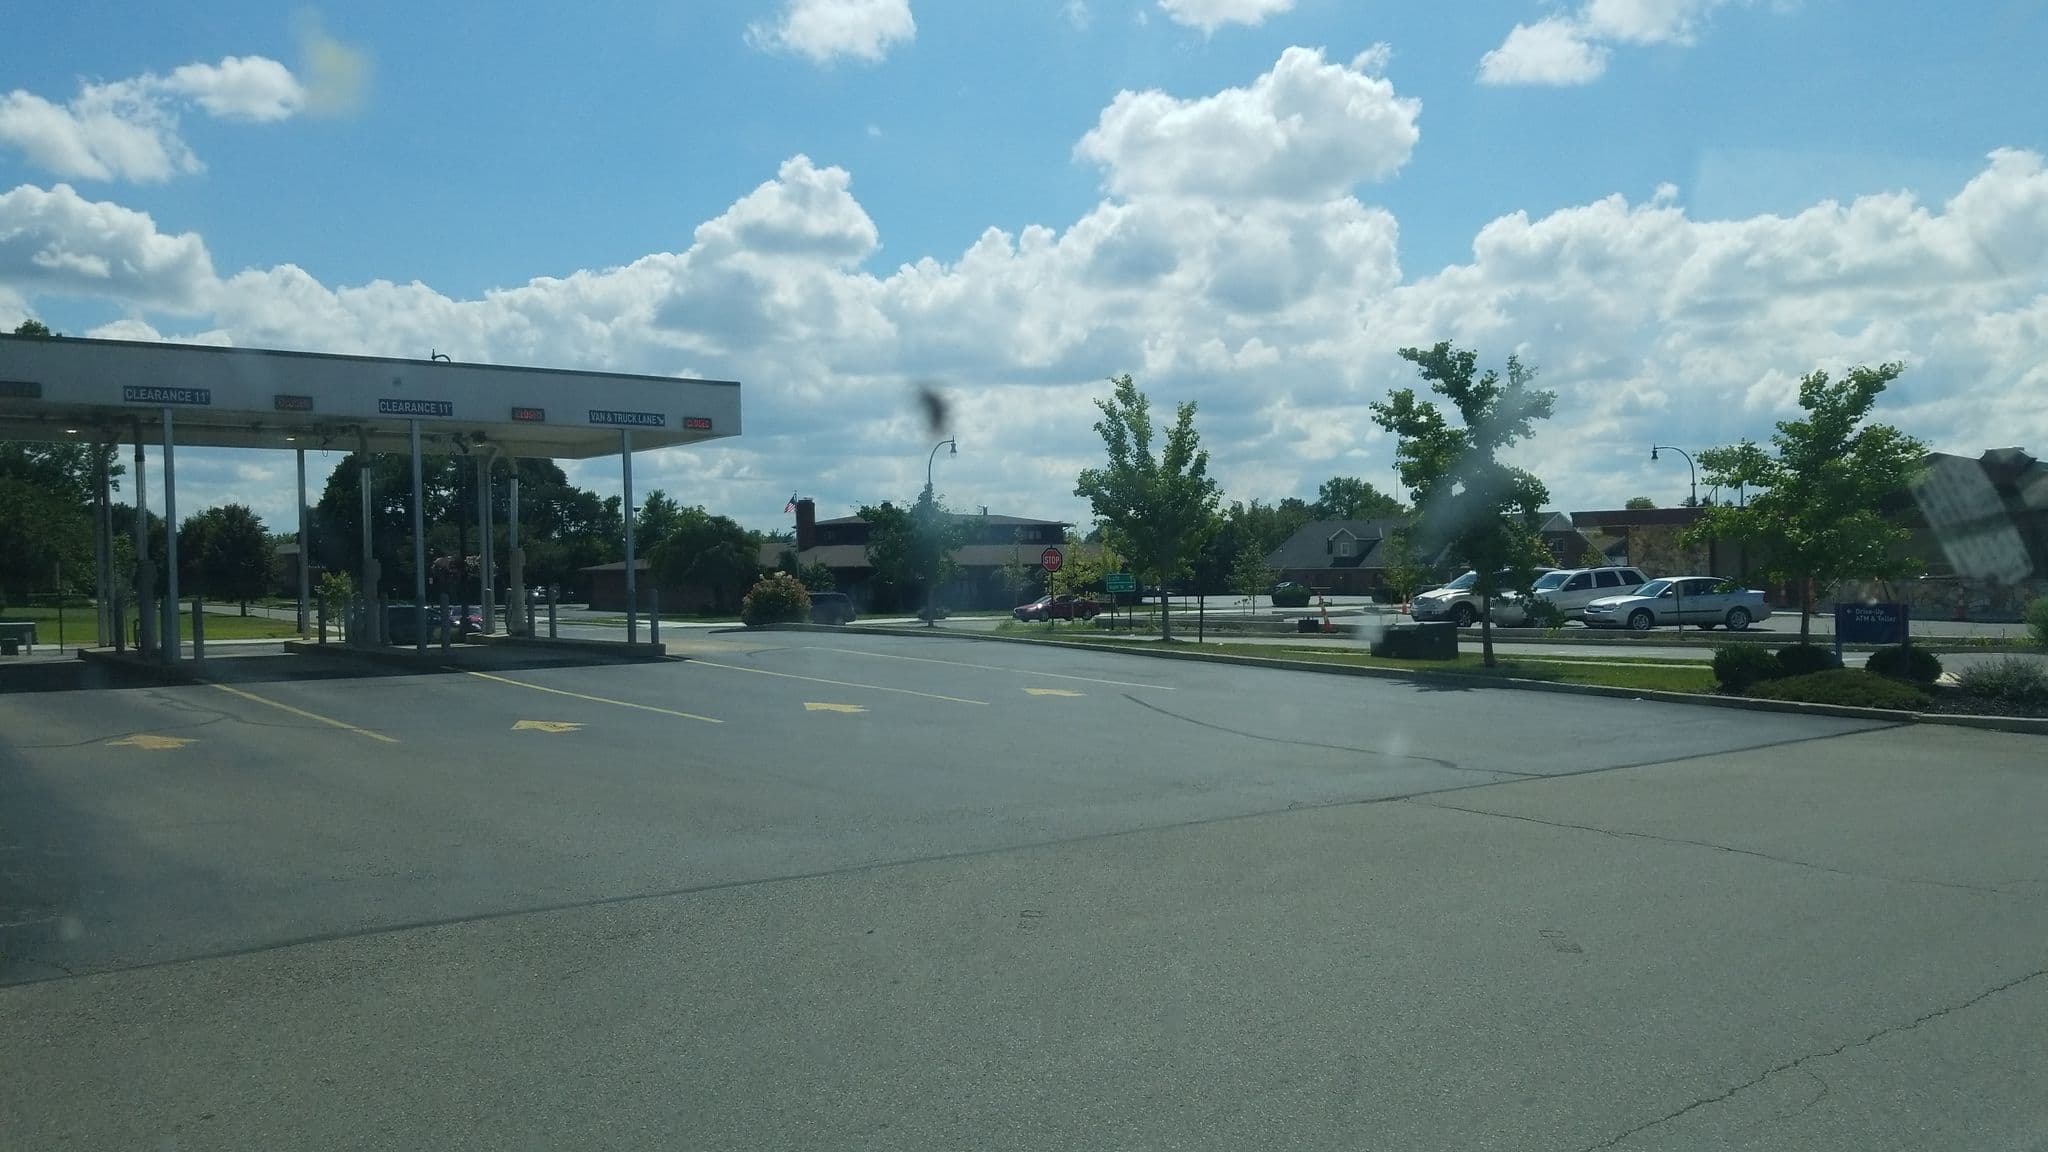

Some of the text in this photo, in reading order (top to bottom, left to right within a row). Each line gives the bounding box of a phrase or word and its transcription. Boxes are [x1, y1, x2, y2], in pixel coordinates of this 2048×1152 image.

[125, 388, 209, 402] CLEARANCE 11'
[380, 401, 437, 414] CLEARANCE
[590, 411, 657, 425] VAN & TRUCK LANE
[1044, 556, 1060, 564] STOP
